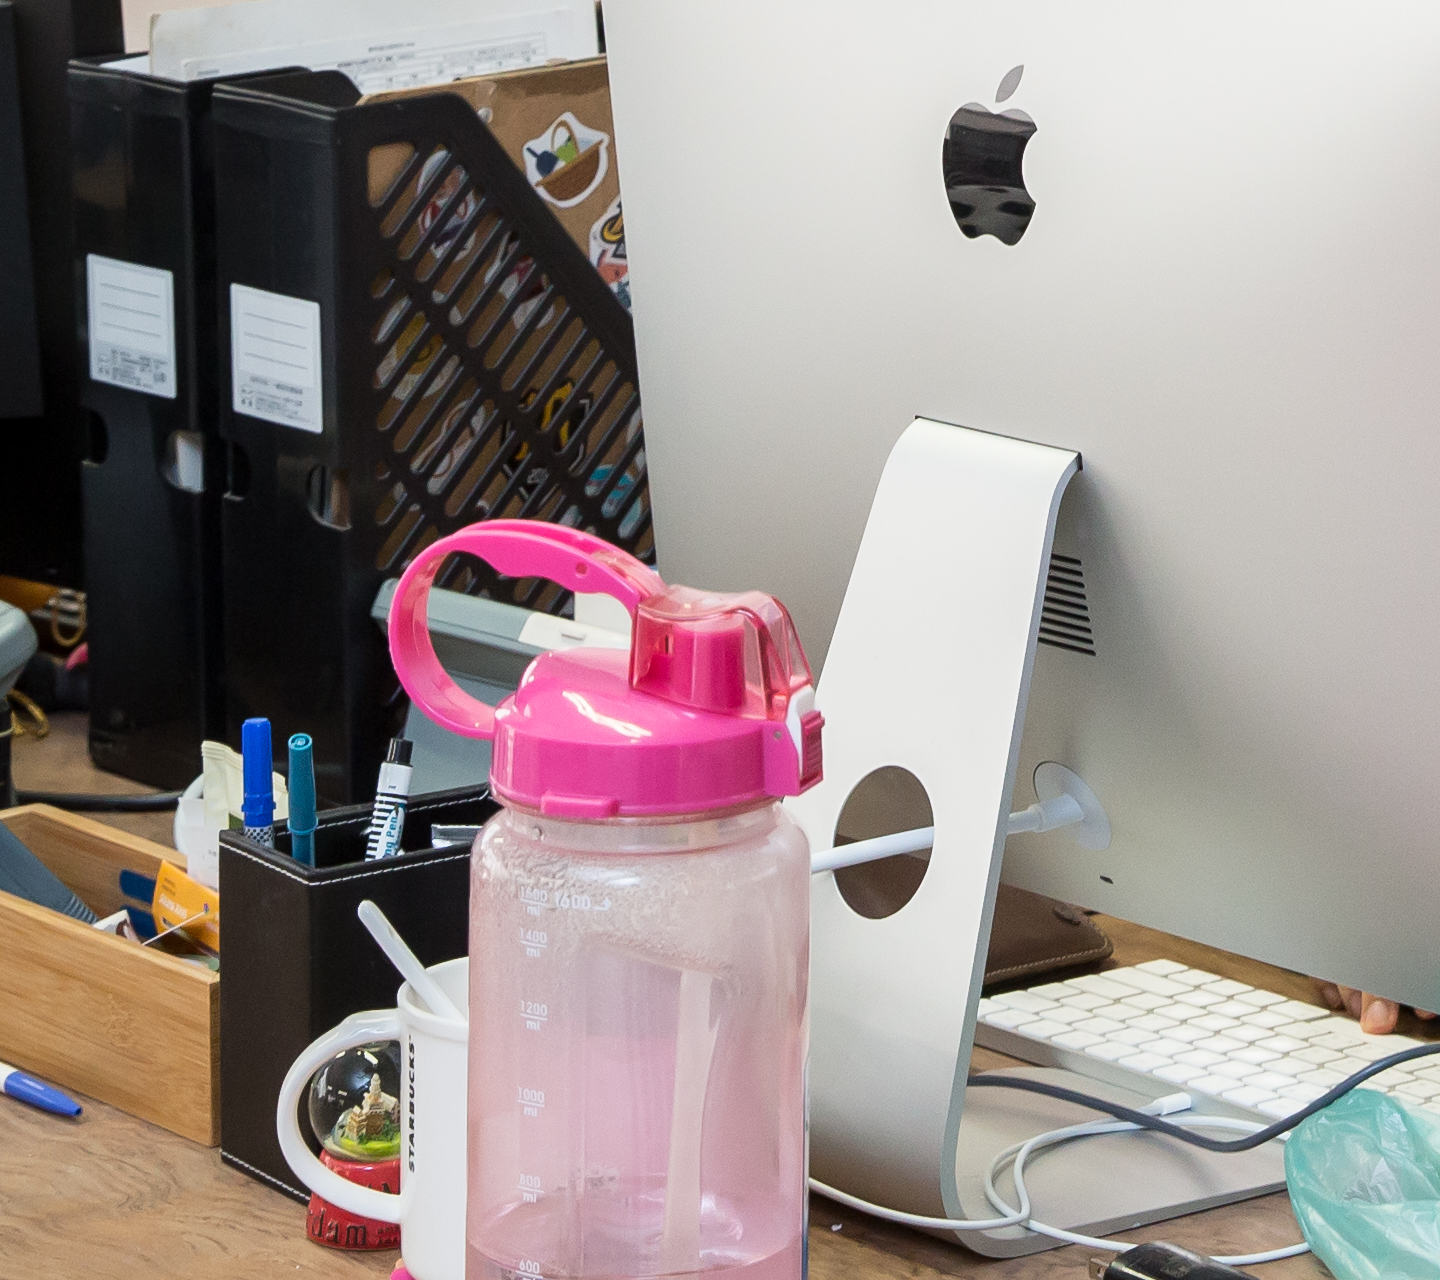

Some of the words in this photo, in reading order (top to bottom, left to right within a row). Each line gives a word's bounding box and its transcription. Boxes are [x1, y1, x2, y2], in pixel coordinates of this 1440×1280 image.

[385, 816, 398, 837] Pen
[554, 892, 591, 910] 1600
[520, 927, 547, 943] 1400
[520, 1000, 548, 1016] 1200
[517, 1086, 545, 1103] 1000
[519, 1173, 541, 1188] 800
[307, 1207, 367, 1246] dam
[519, 1259, 540, 1274] 600
